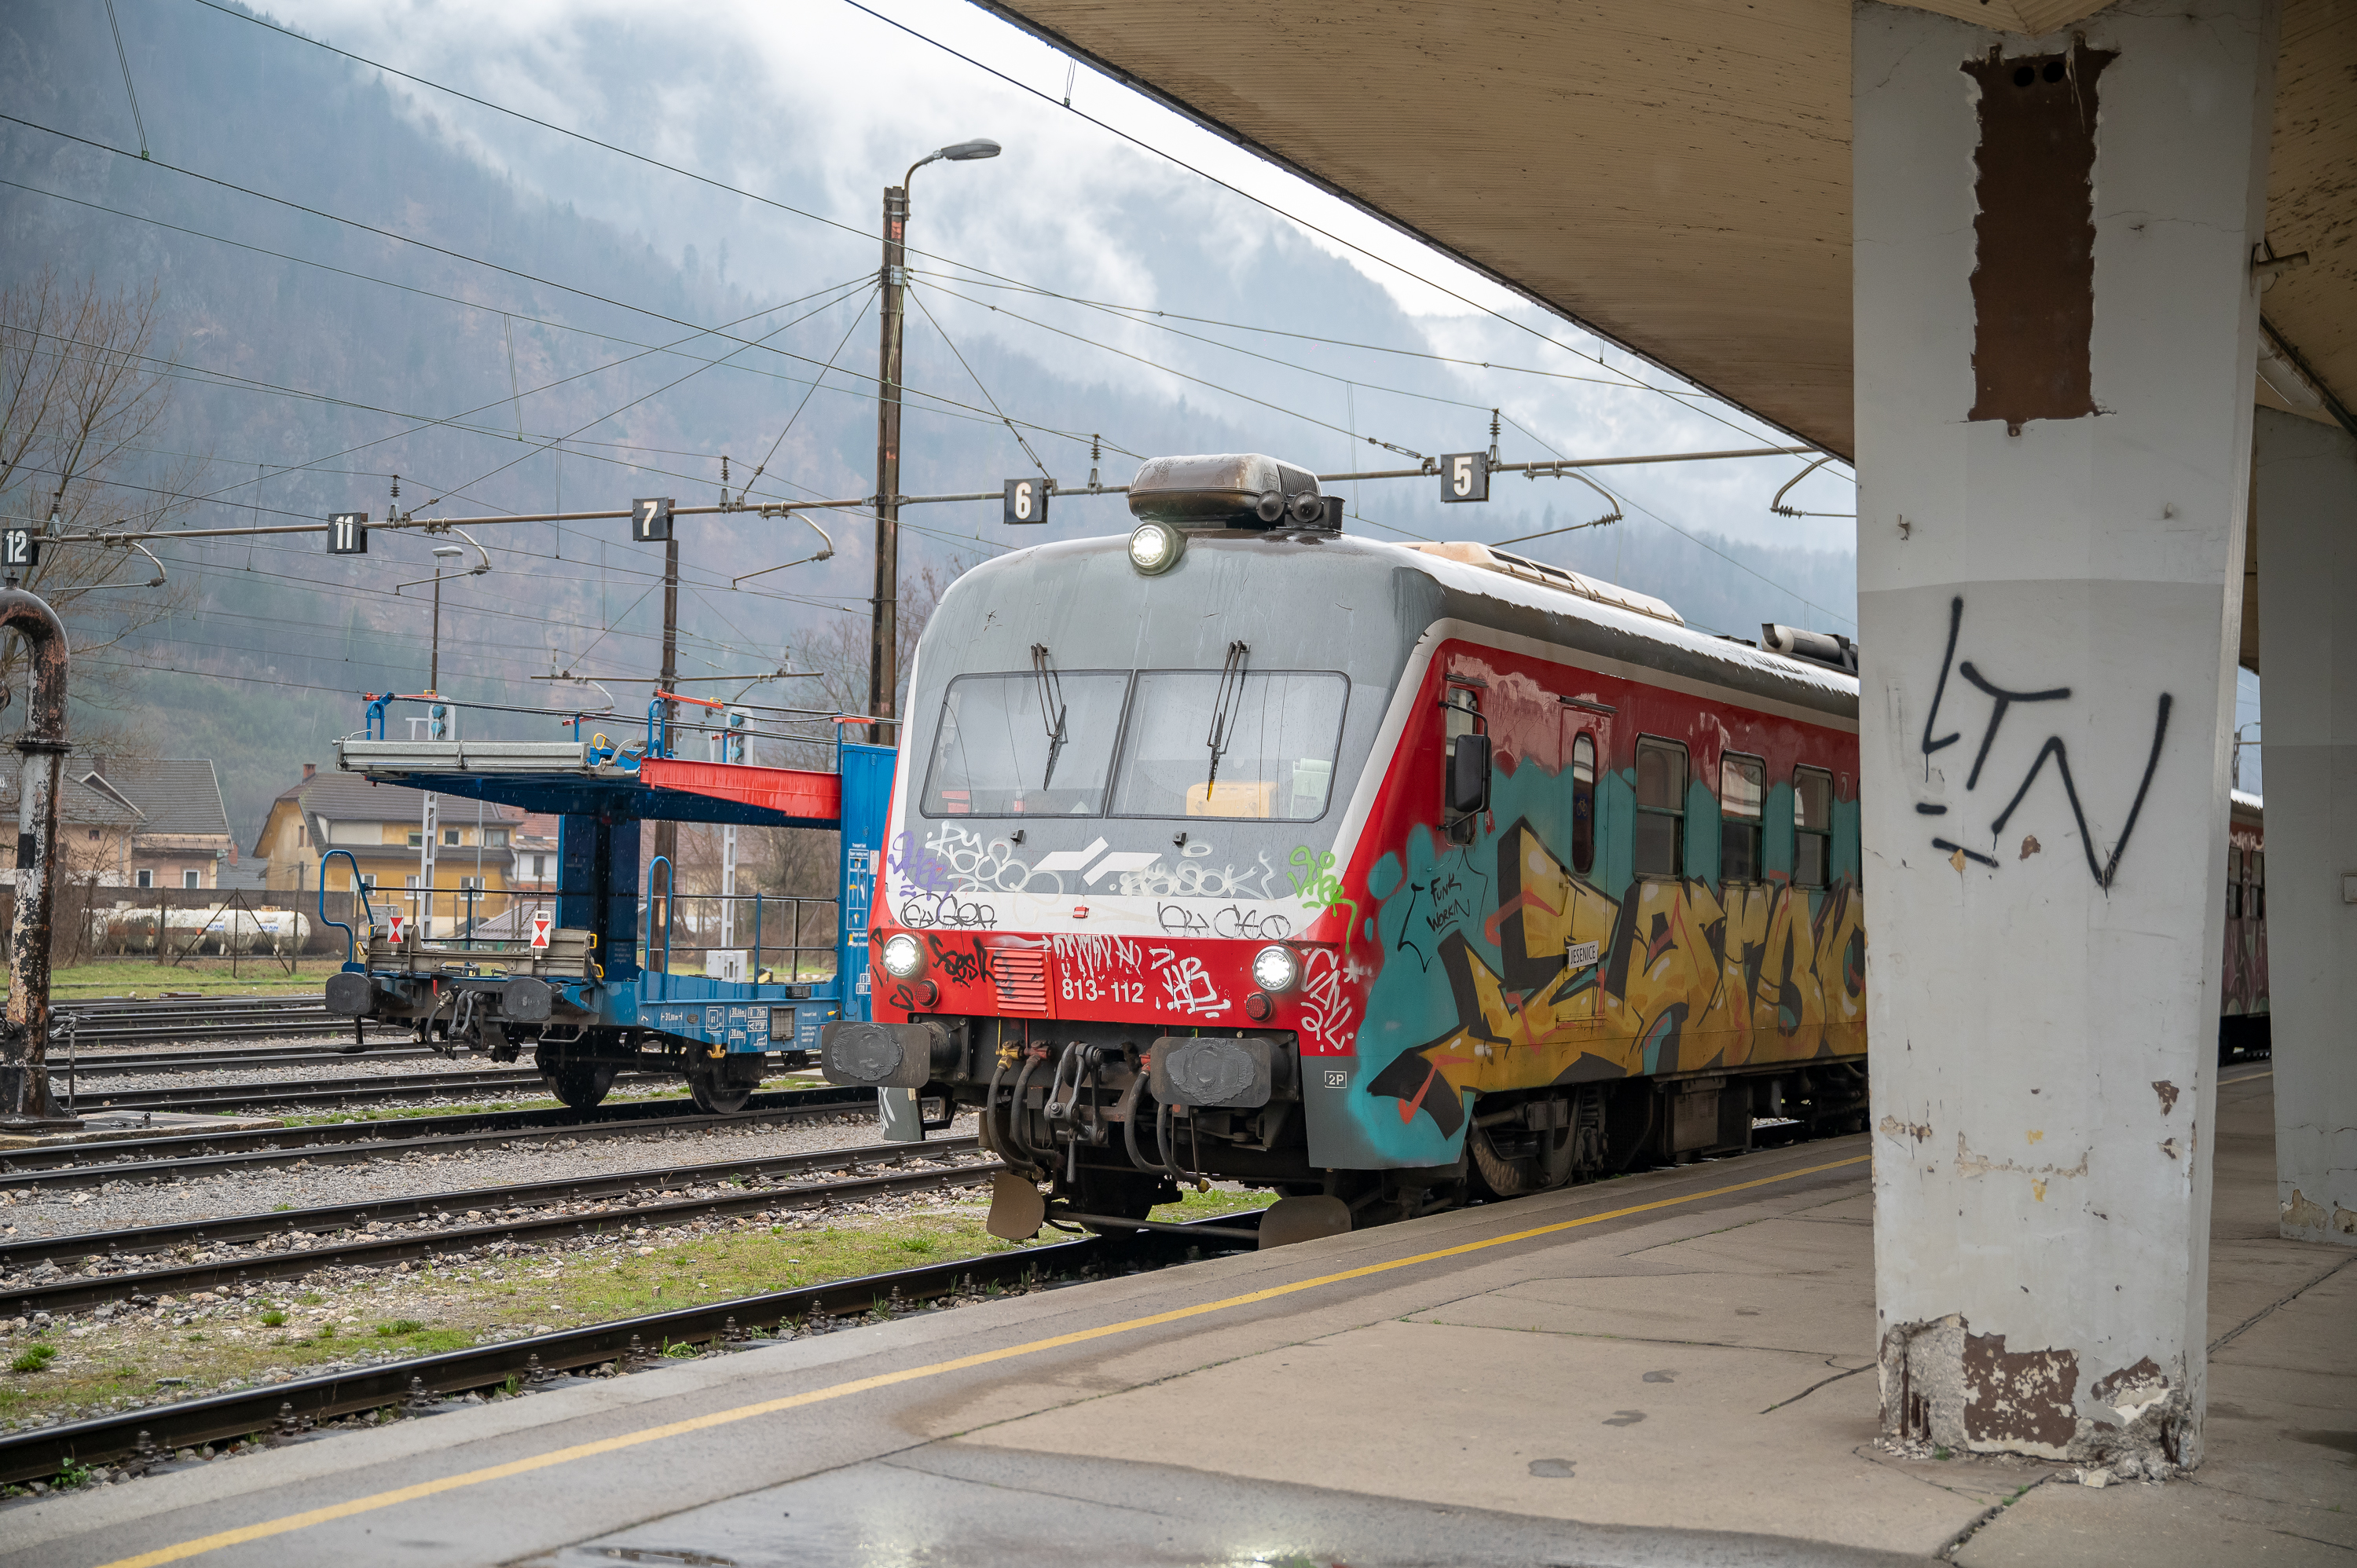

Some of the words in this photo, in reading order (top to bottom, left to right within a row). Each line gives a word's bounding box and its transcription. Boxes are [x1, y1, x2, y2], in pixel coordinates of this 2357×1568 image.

[1453, 456, 1472, 496] 5
[641, 500, 658, 537] 7
[1014, 482, 1032, 520] 6
[7, 529, 27, 563] 12
[335, 515, 354, 551] 11
[1570, 944, 1596, 965] JESENICE
[1328, 1074, 1344, 1086] 2P
